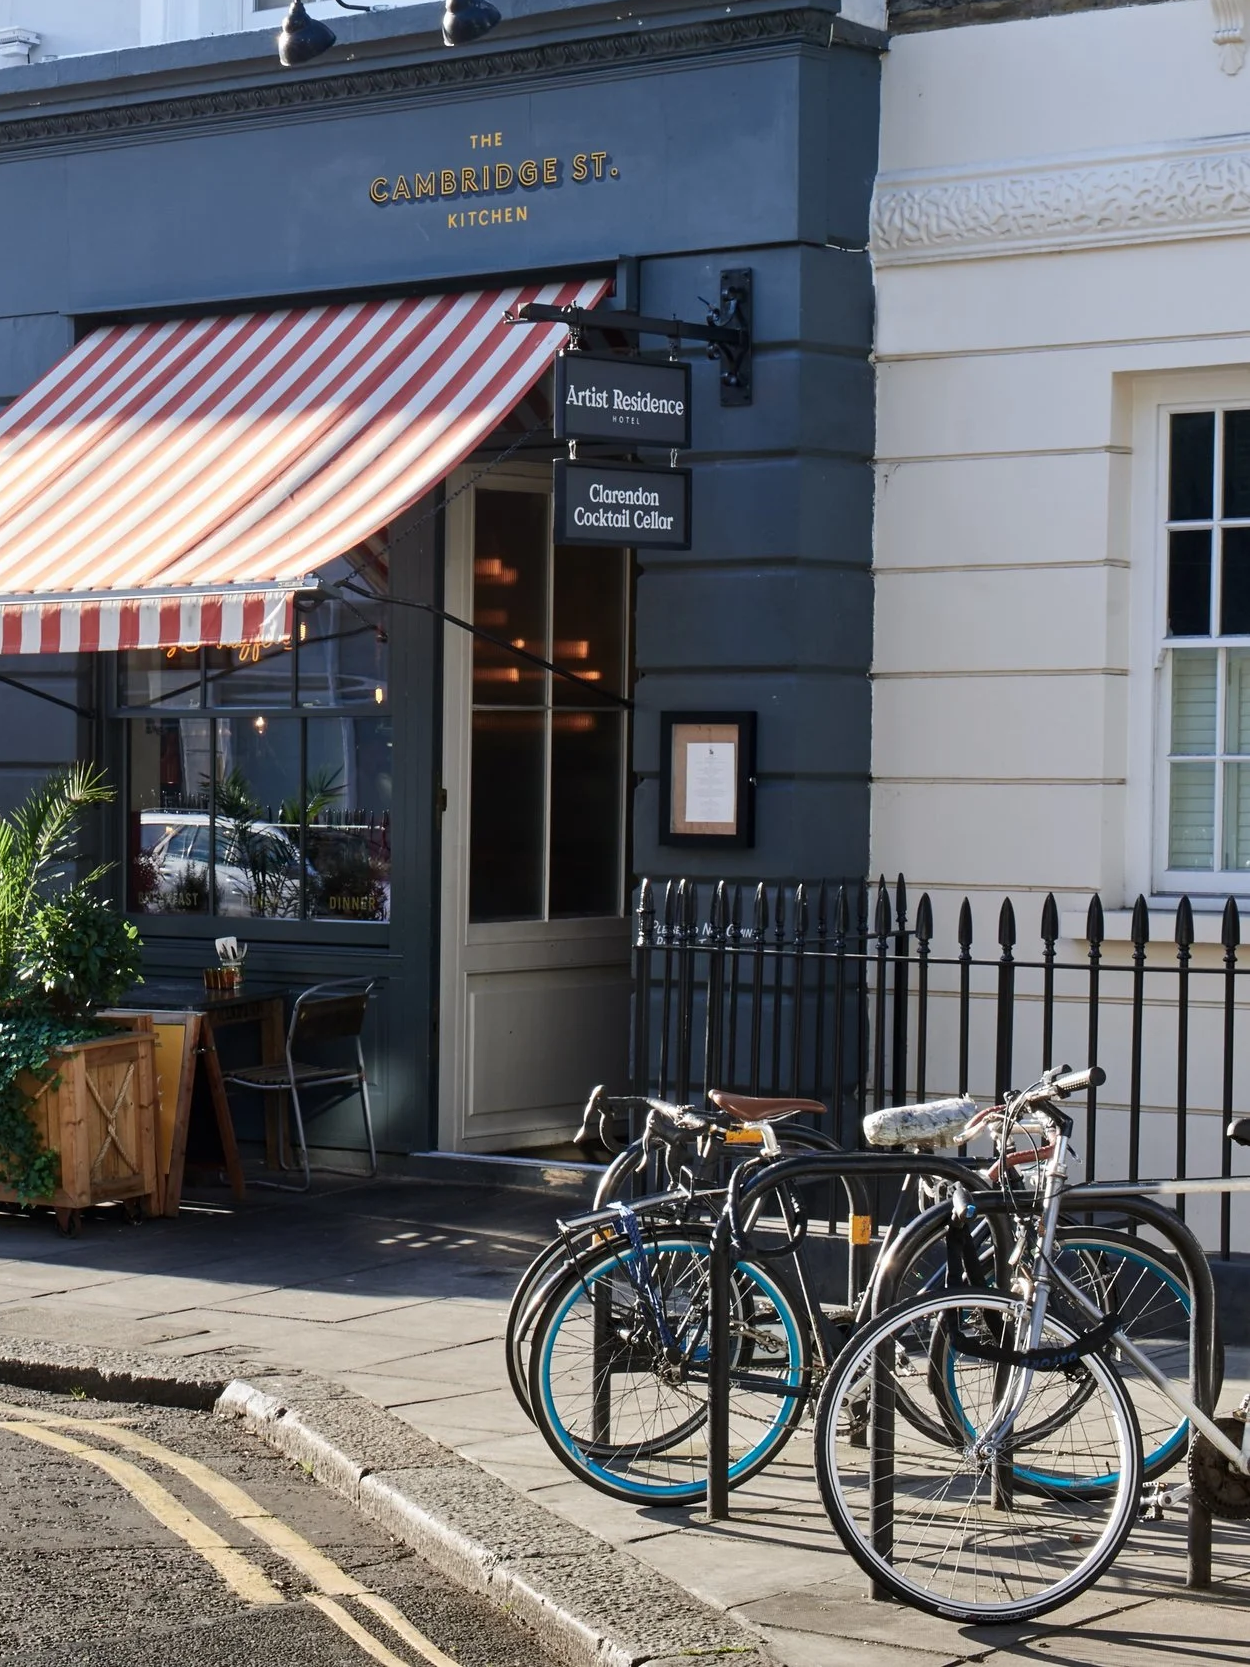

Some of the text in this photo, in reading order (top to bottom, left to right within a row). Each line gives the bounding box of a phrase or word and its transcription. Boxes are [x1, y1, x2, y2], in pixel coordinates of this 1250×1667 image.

[470, 132, 503, 149] THE
[369, 151, 619, 203] CAMBRIDGE ST.
[448, 205, 528, 229] KITCHEN
[566, 385, 684, 415] Artist Residence
[612, 415, 640, 425] HOTEL
[589, 484, 660, 506] Clarendon
[574, 506, 674, 530] Cocktail Cellar
[330, 896, 376, 911] DINNER
